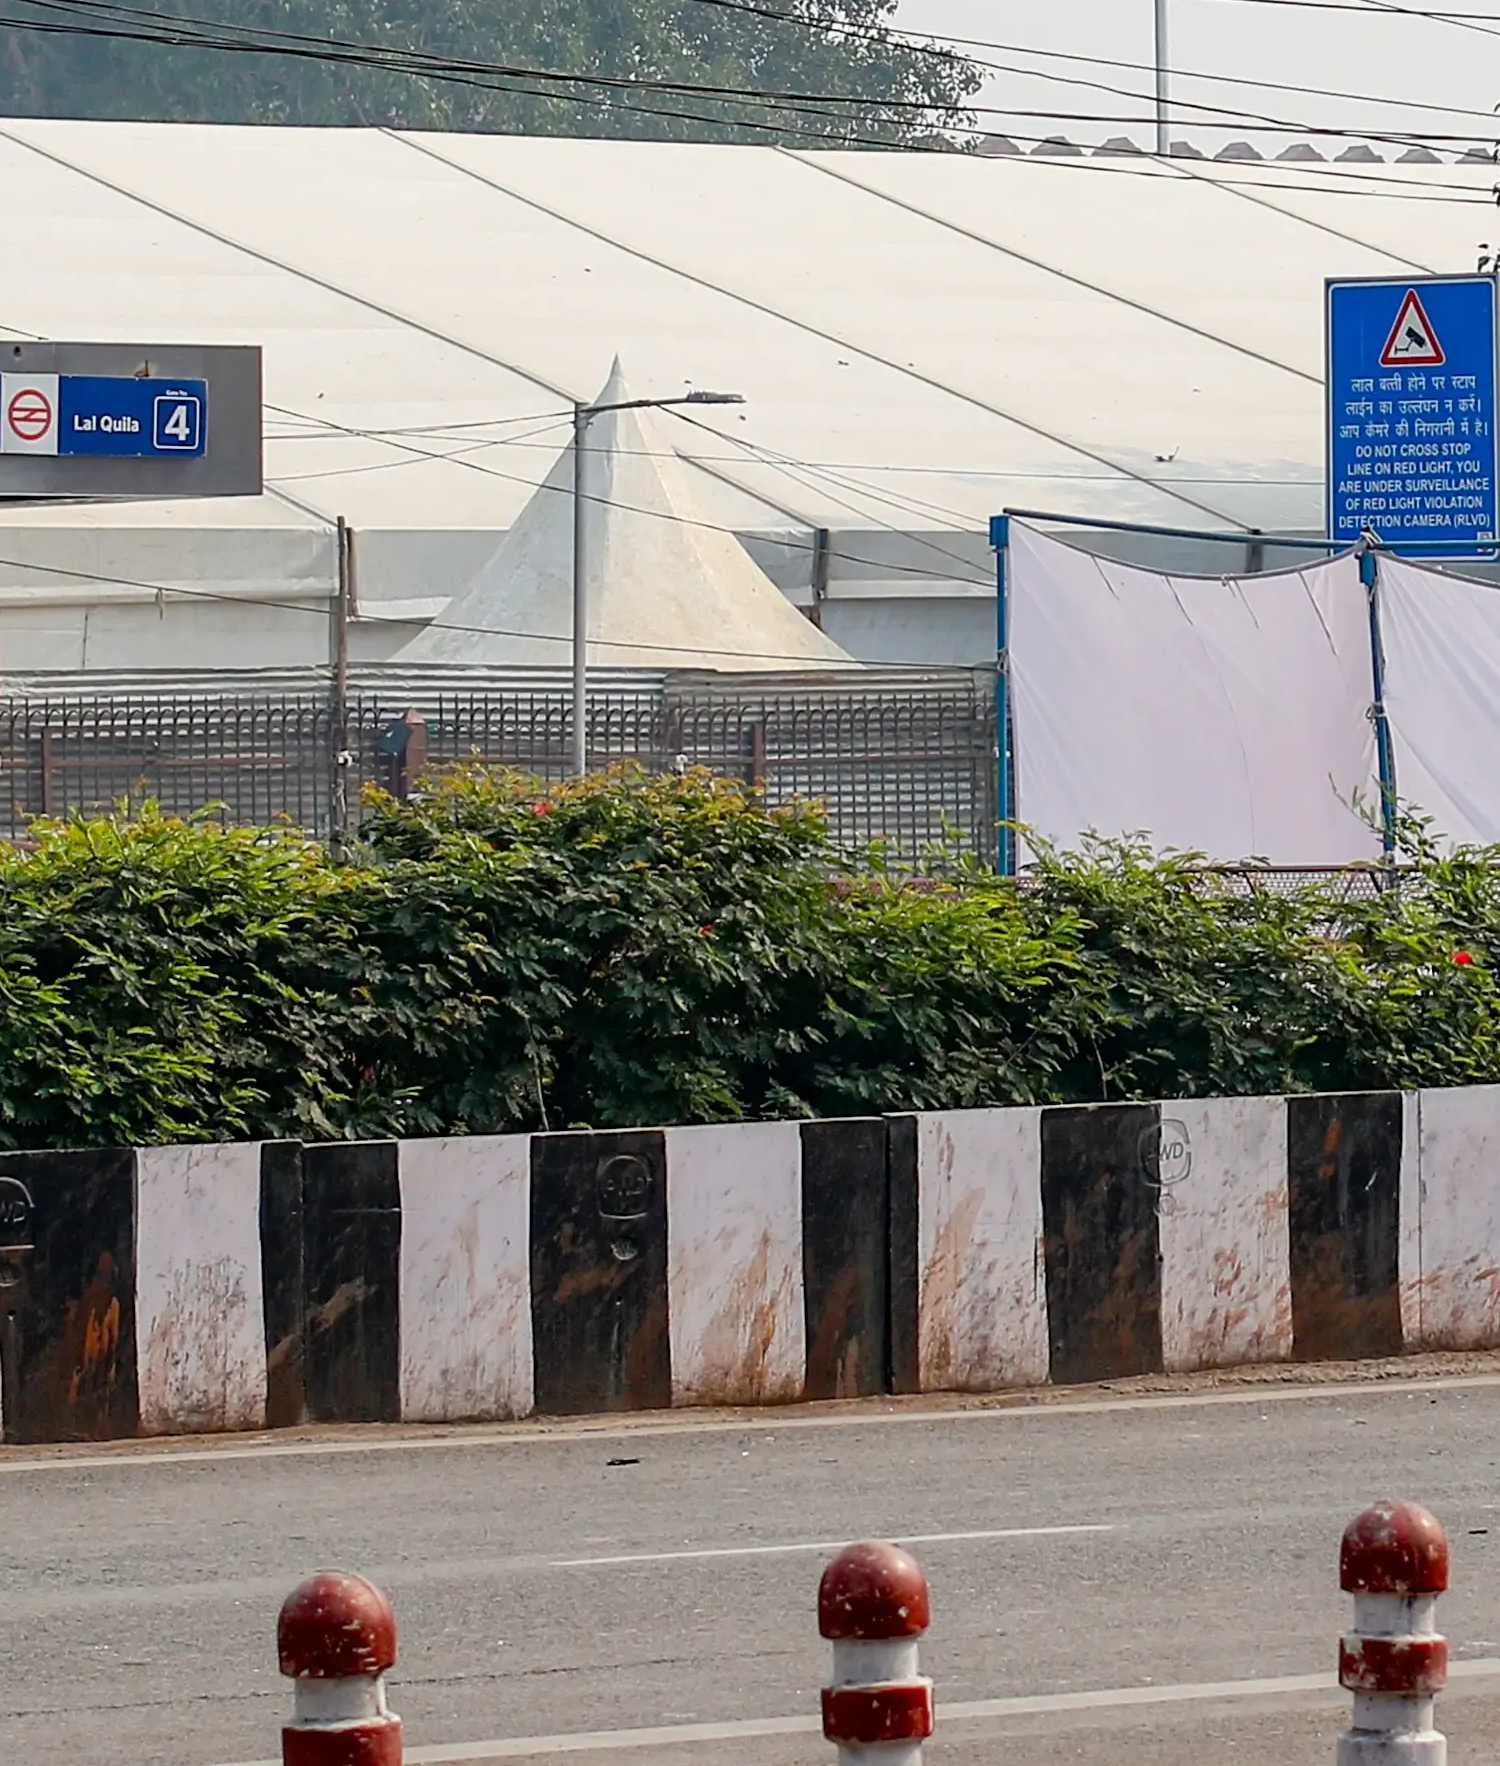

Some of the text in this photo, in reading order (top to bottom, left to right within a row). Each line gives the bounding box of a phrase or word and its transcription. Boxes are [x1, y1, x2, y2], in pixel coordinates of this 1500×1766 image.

[1351, 377, 1375, 393] लाल
[1408, 371, 1426, 392] होने
[1432, 375, 1446, 390] पर
[1379, 400, 1393, 415] का
[1444, 399, 1453, 413] न
[74, 415, 140, 433] Lal Quila
[164, 405, 190, 441] 4
[1339, 424, 1360, 439] आप
[1395, 418, 1410, 438] की
[1414, 417, 1456, 437] निगरानी
[1356, 442, 1472, 458] DO NOT CROSS STOP
[1347, 460, 1481, 476] LINE ON RED LIGHT, YOU
[1338, 477, 1491, 493] ARE UNDER SURVEILLANCE
[1345, 495, 1484, 511] OF RED LIGHT VIOLATION
[1338, 513, 1491, 528] DETECTION CAMERA (RLVD)
